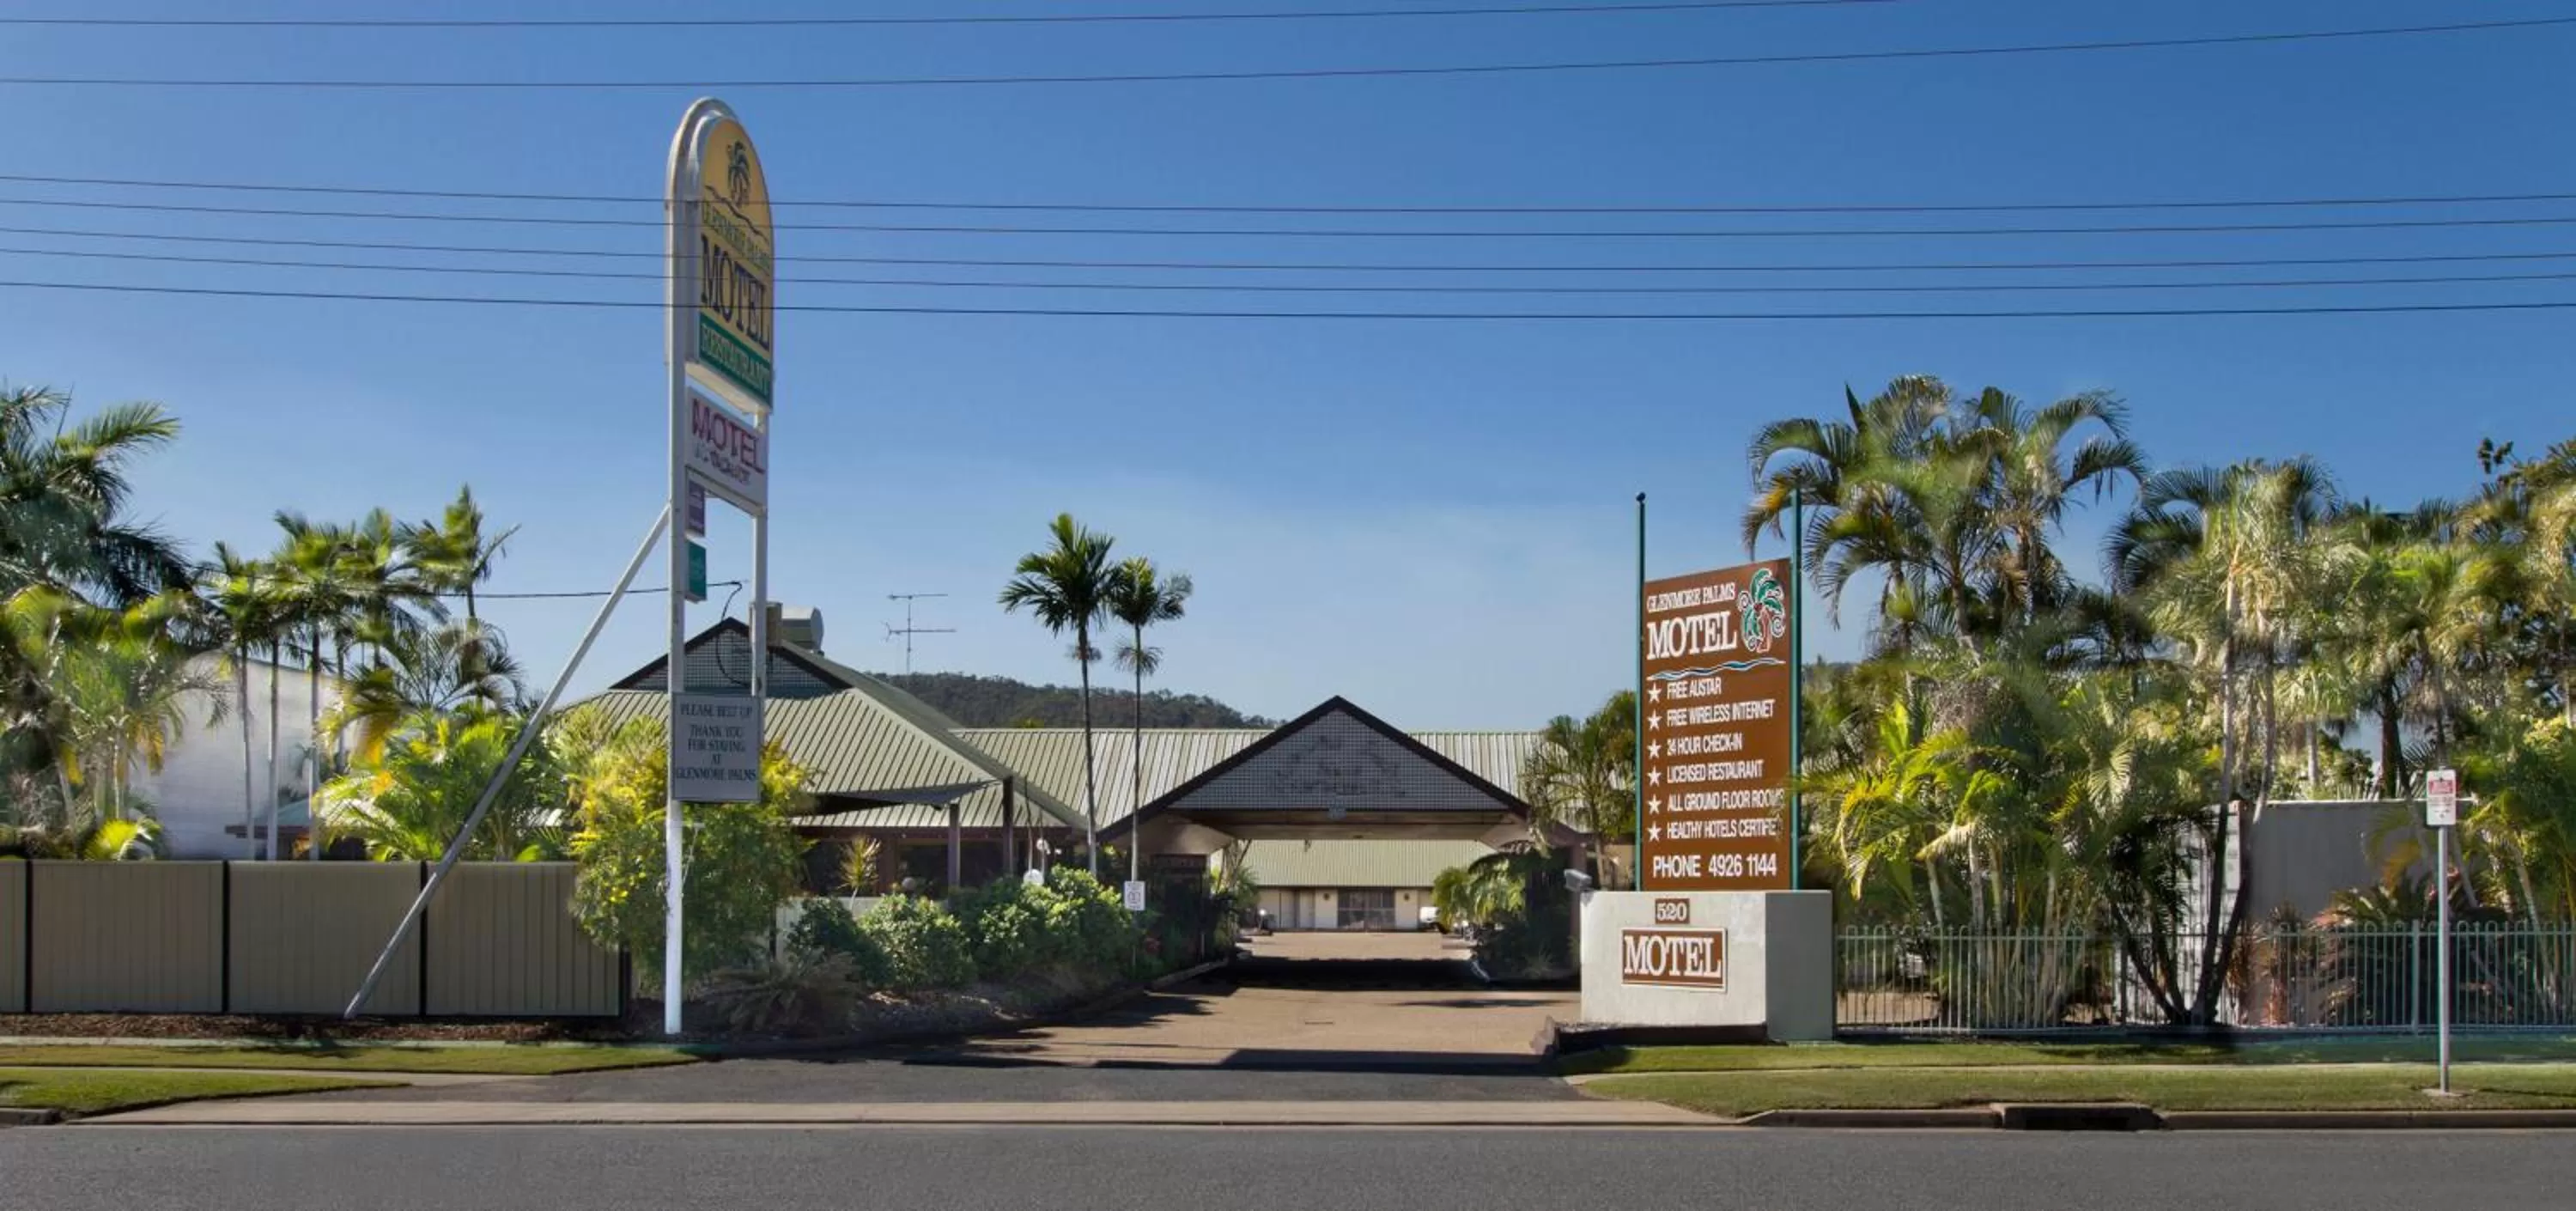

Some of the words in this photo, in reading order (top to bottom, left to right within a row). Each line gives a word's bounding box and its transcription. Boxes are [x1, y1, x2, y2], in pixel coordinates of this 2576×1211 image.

[701, 233, 770, 352] MOTEL
[701, 323, 771, 397] RESTAURANT
[692, 398, 765, 474] MOTEL
[1646, 587, 1701, 614] GLENMORE
[1703, 581, 1736, 604] PALMS
[1646, 611, 1738, 660] MOTEL
[1667, 680, 1688, 700] FREE
[1689, 677, 1722, 698] AUSTAR
[680, 703, 714, 716] PLEASE
[1667, 708, 1688, 727] FREE
[1689, 703, 1730, 725] WIRELESS
[1732, 698, 1776, 721] INTERNET
[690, 724, 721, 738] THANK
[725, 726, 744, 738] YOU
[688, 739, 707, 752] FOR
[708, 739, 745, 753] STAYING
[1667, 739, 1677, 757] 24
[1678, 735, 1701, 755] HOUR
[1703, 732, 1743, 753] CHECK-IN
[712, 754, 721, 764] AT
[1667, 764, 1706, 784] LICENSED
[1708, 759, 1765, 782] RESTAURANT
[676, 766, 725, 781] GLENMORE
[1667, 794, 1684, 812] ALL
[1685, 790, 1720, 812] GROUND
[1722, 788, 1750, 810] FLOOR
[1667, 820, 1703, 839] HEALTHY
[1704, 818, 1737, 838] HOTELS
[1652, 855, 1701, 879] PHONE
[1708, 853, 1742, 877] 4926
[1746, 852, 1777, 877] 1144
[1656, 902, 1687, 922] 520
[1624, 934, 1722, 978] MOTEL
